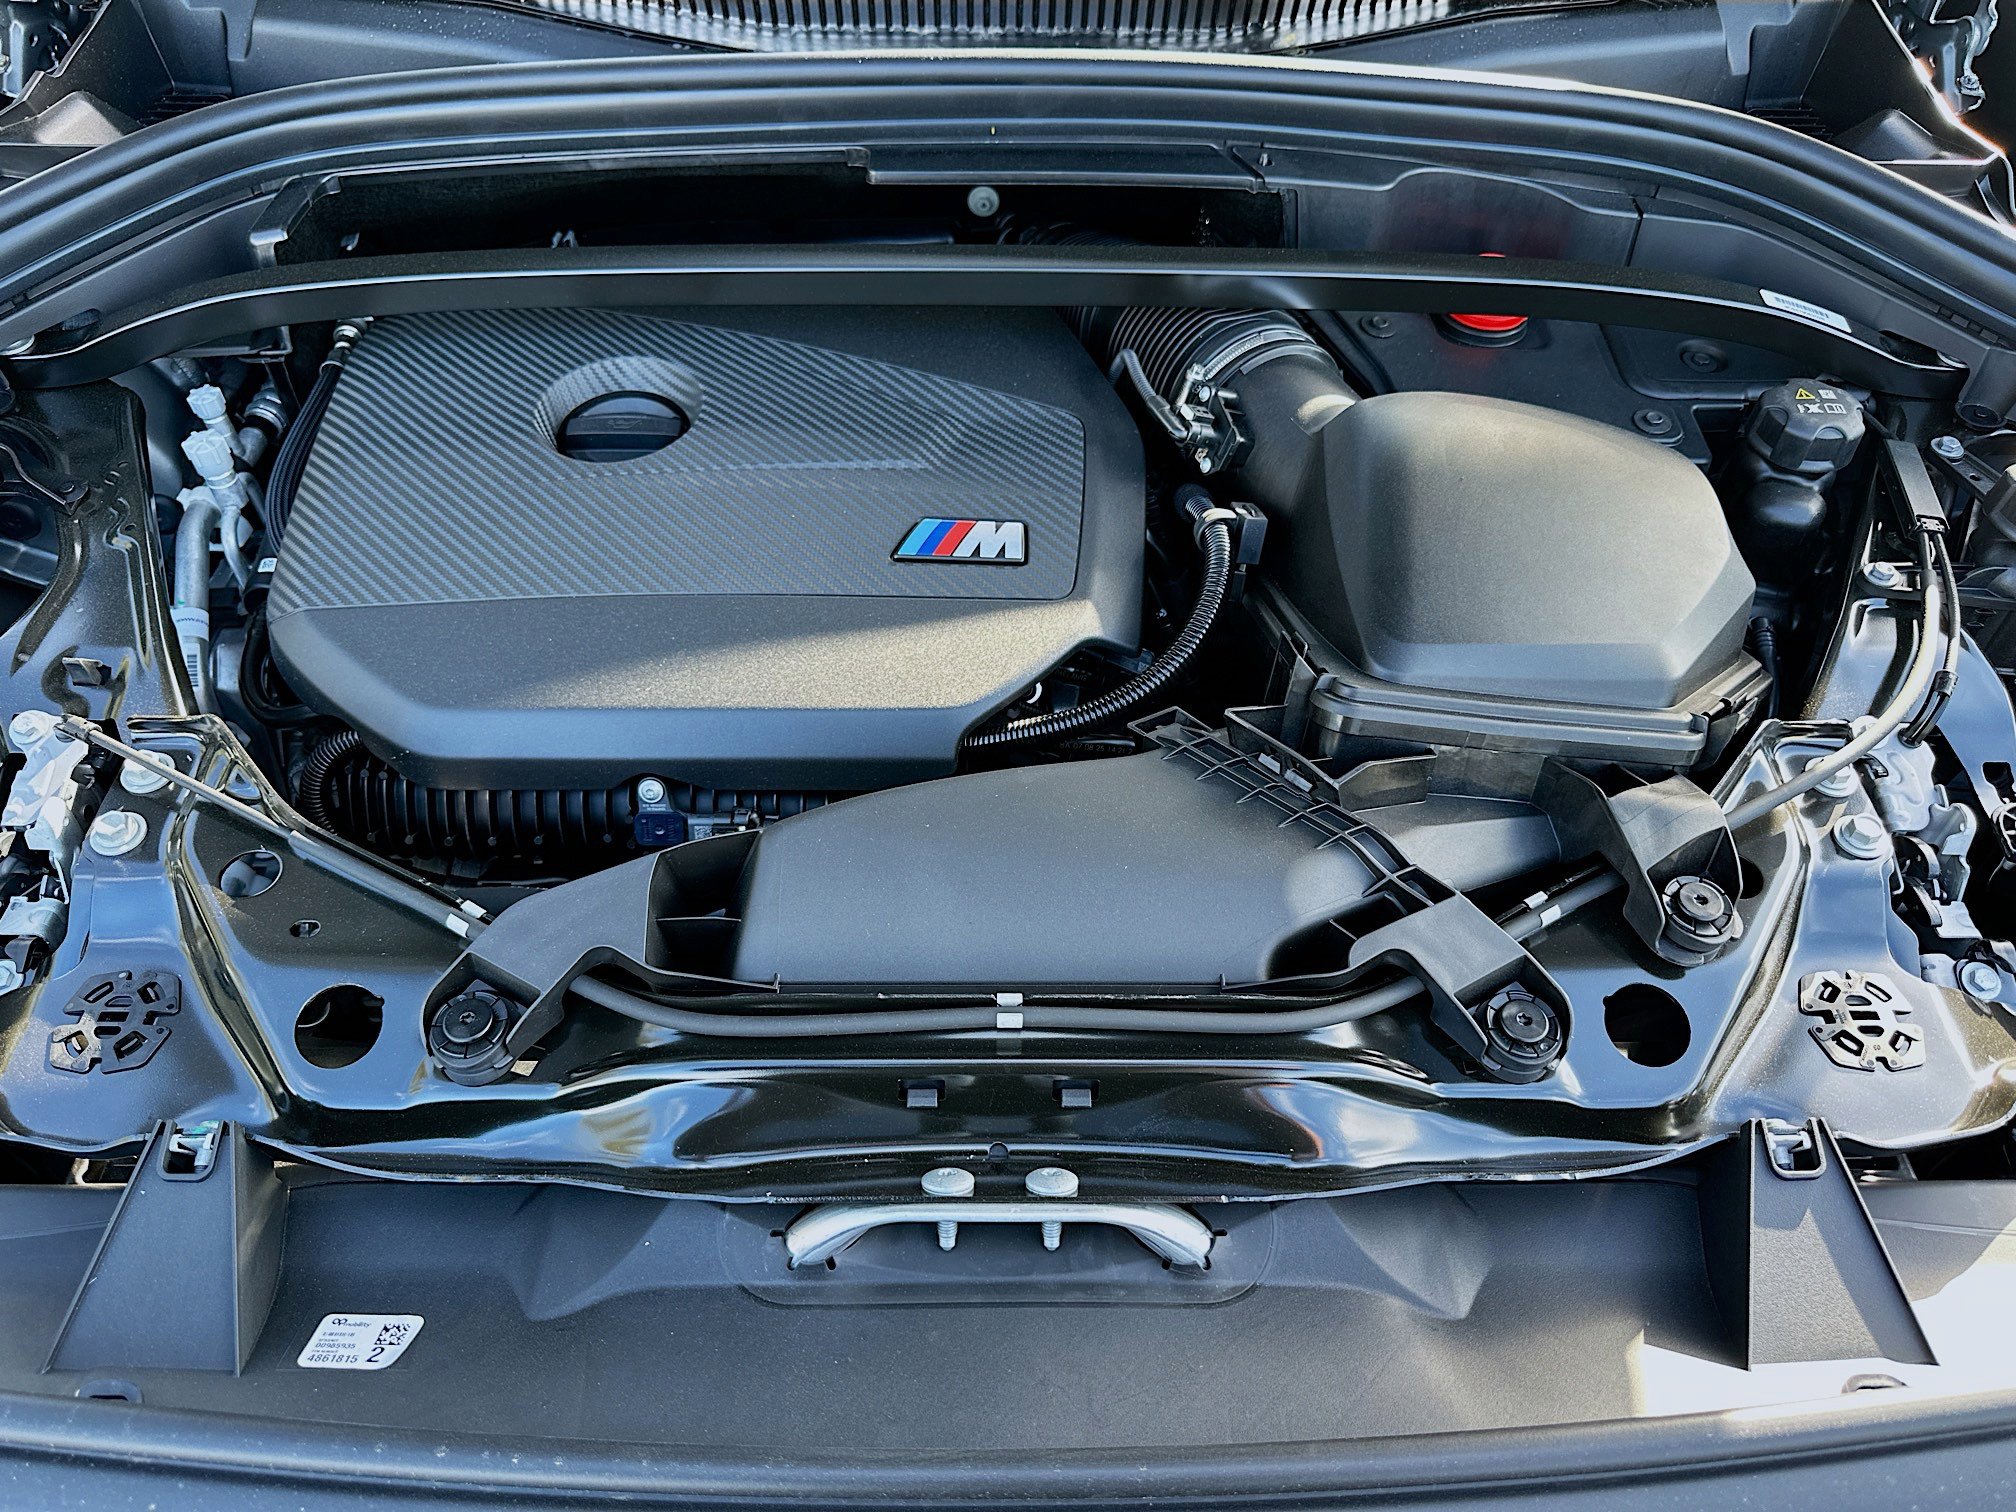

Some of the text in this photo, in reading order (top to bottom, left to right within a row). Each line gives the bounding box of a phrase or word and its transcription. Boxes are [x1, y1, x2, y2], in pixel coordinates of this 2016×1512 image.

[952, 520, 1024, 559] M
[307, 1353, 359, 1364] 4861815
[365, 1346, 385, 1363] 2
